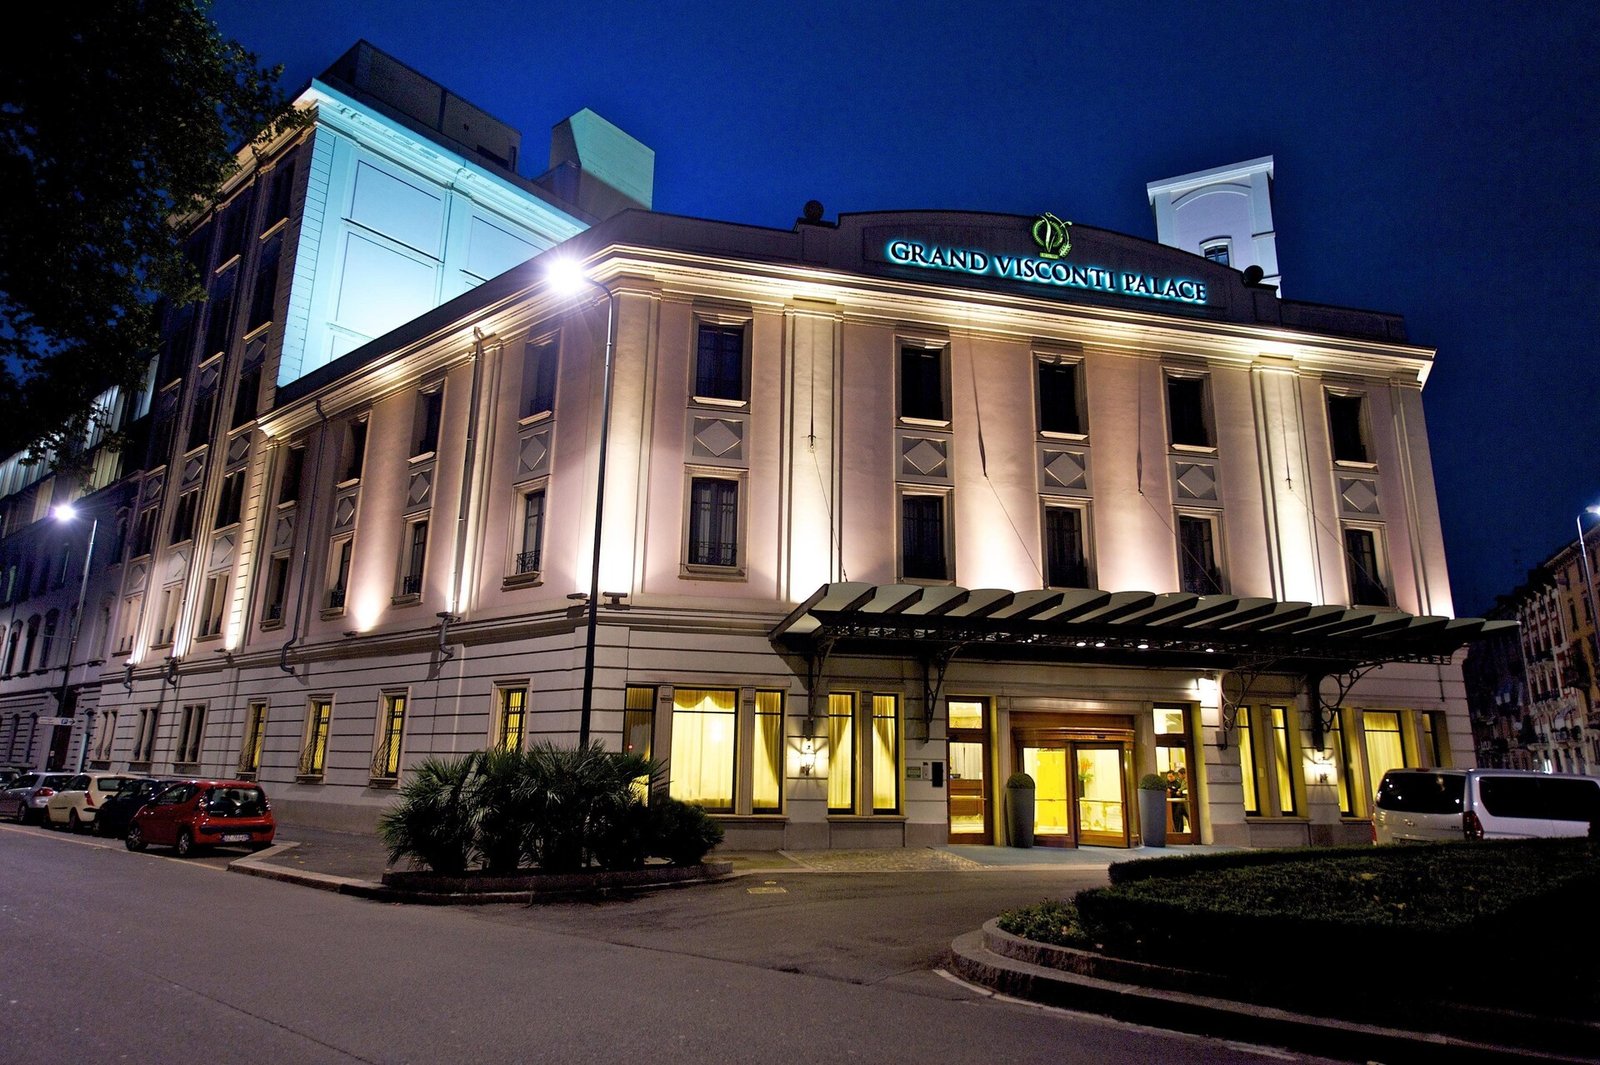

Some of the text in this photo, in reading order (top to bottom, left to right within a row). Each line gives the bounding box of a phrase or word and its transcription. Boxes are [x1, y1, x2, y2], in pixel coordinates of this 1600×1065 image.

[889, 240, 1207, 301] GRAND VISCONTI PALACE
